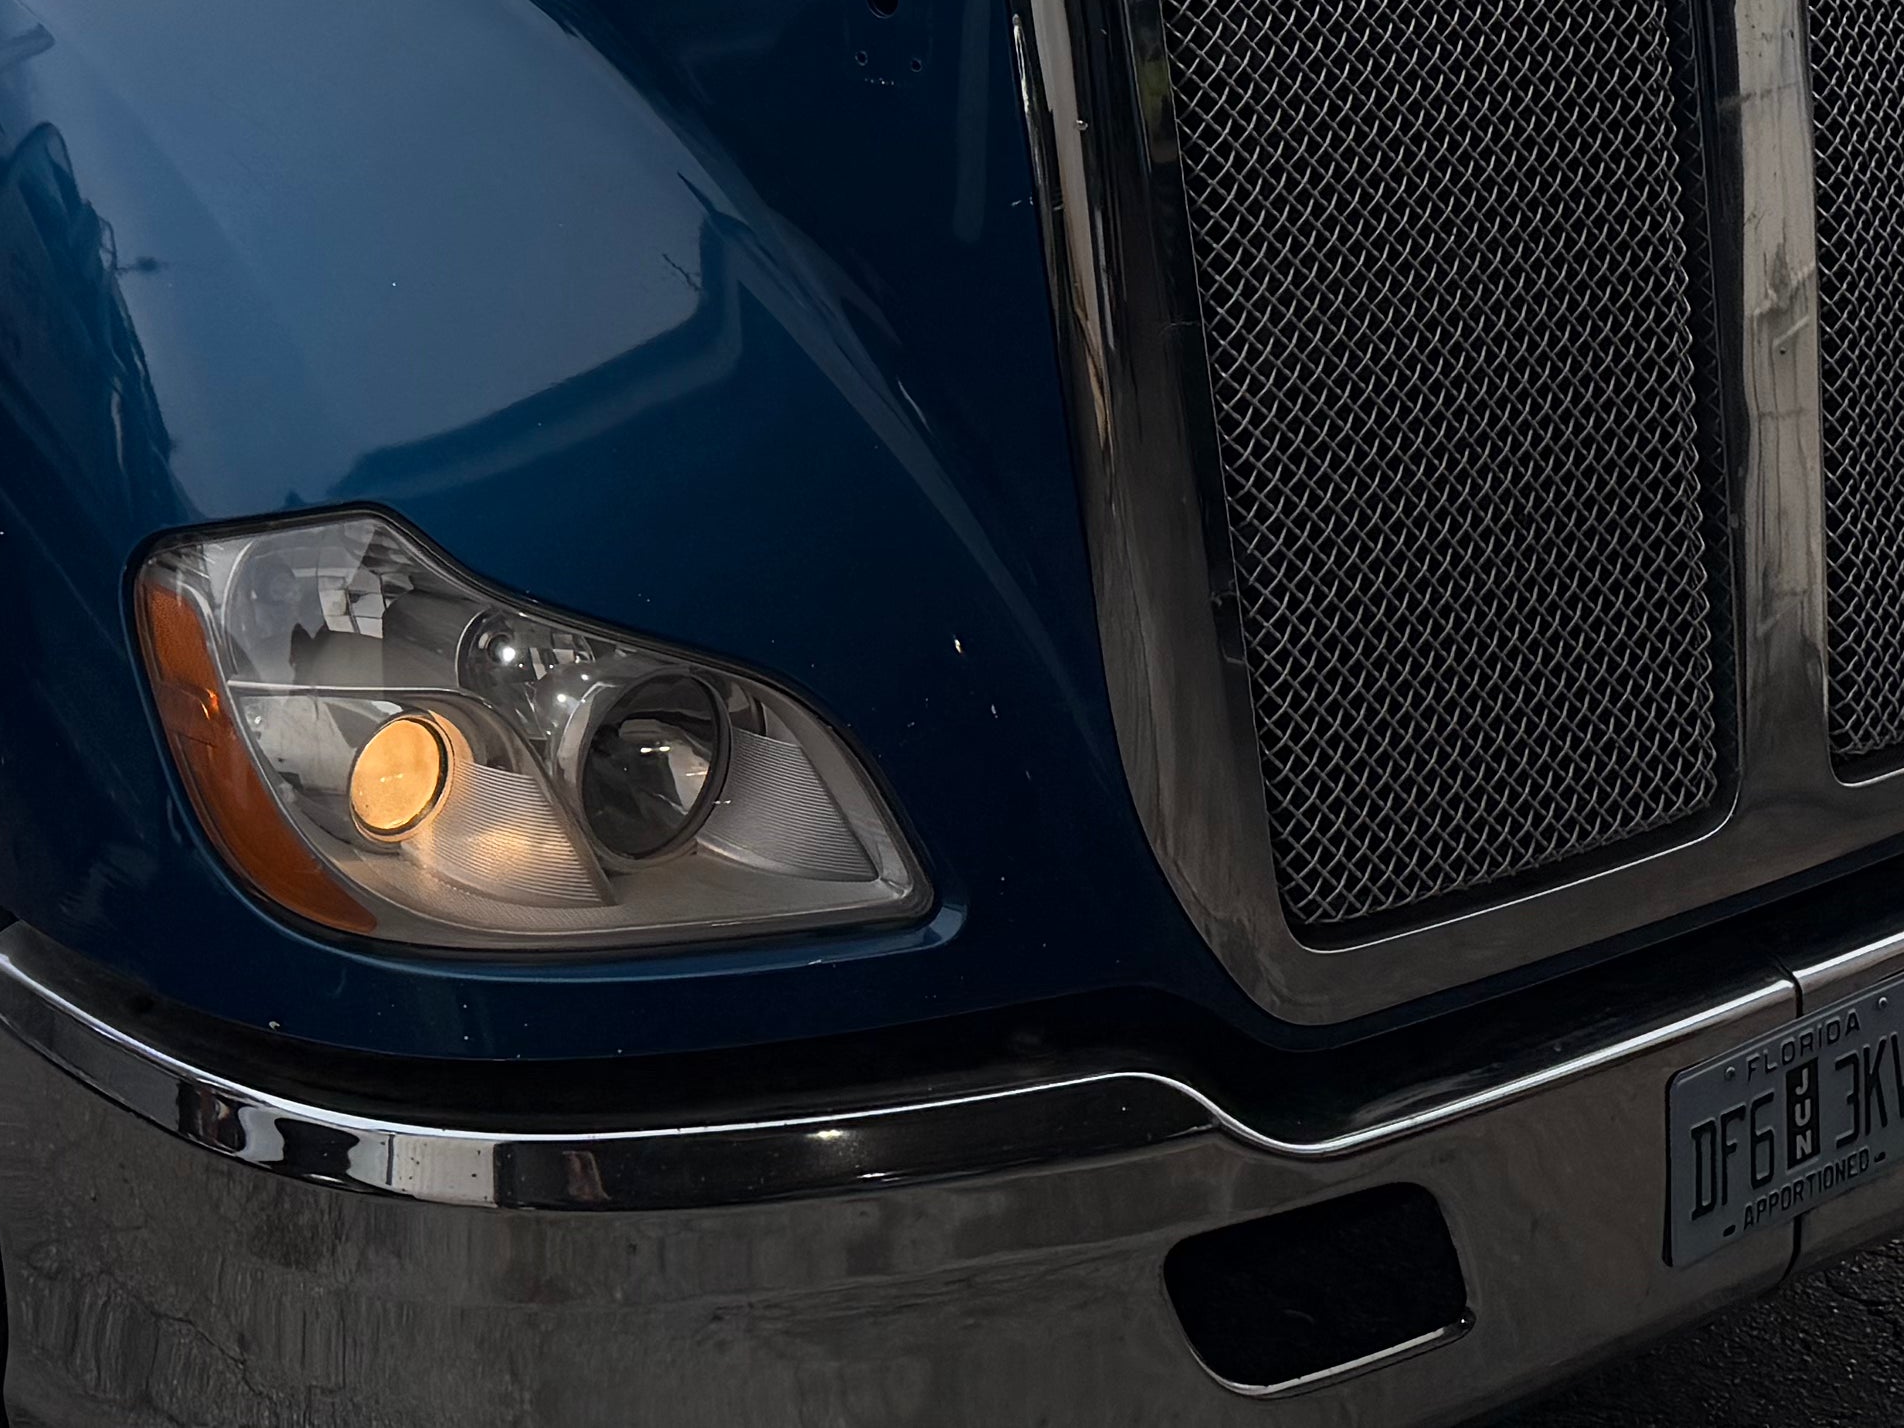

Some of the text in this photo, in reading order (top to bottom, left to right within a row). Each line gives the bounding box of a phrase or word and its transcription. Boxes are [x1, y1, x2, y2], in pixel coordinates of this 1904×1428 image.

[1746, 1010, 1862, 1082] FLORIDA
[1690, 1090, 1775, 1222] DF6
[1793, 1066, 1814, 1162] JUN
[1742, 1148, 1870, 1232] APPORTIONED
